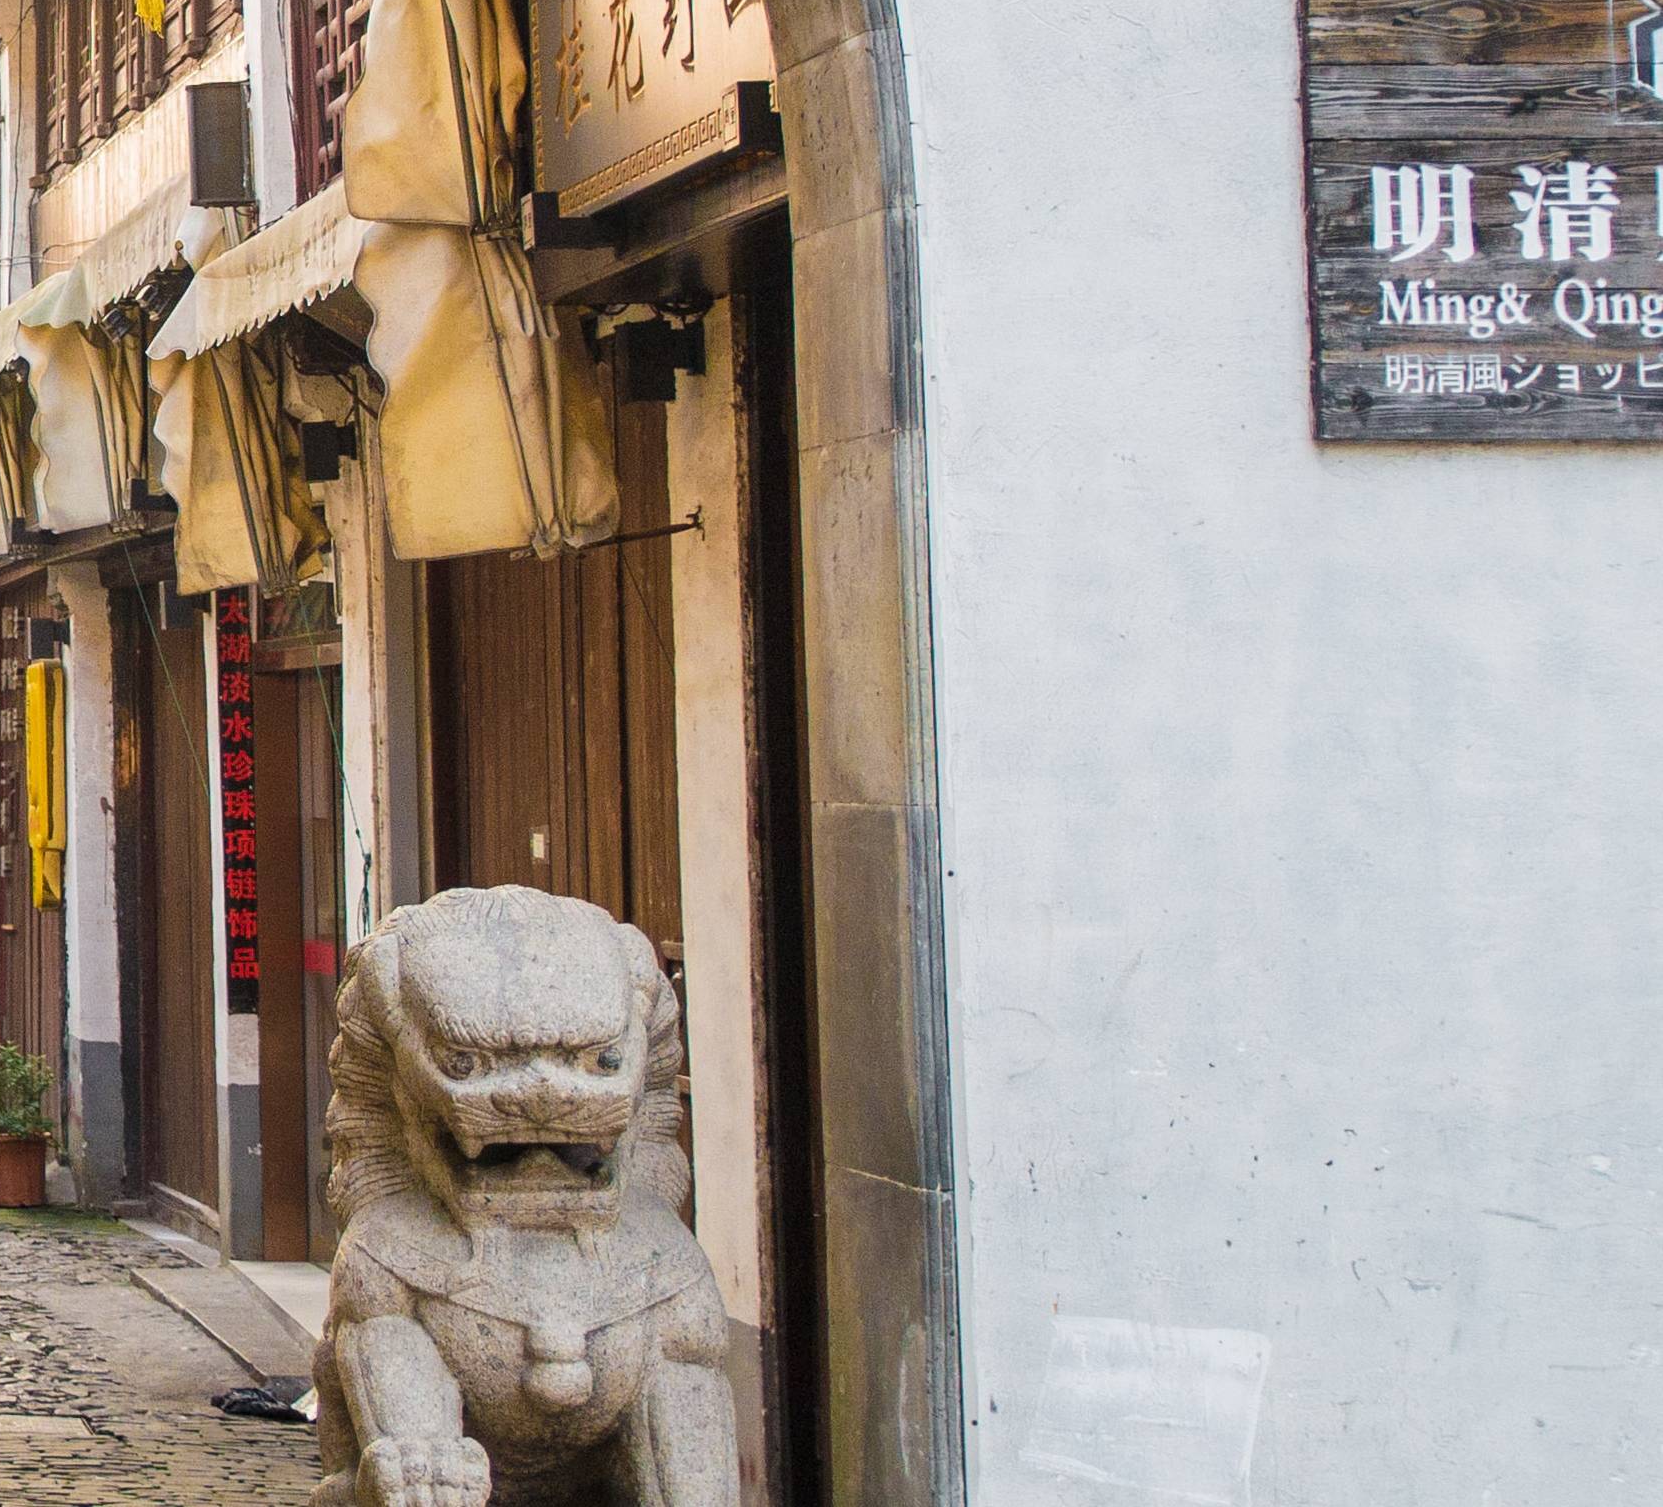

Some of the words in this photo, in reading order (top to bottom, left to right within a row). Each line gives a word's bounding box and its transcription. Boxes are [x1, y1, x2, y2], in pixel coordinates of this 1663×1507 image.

[1372, 160, 1663, 263] 明清
[1378, 278, 1532, 338] Ming&
[219, 595, 259, 979] 太湖淡水珍珠项链饰品
